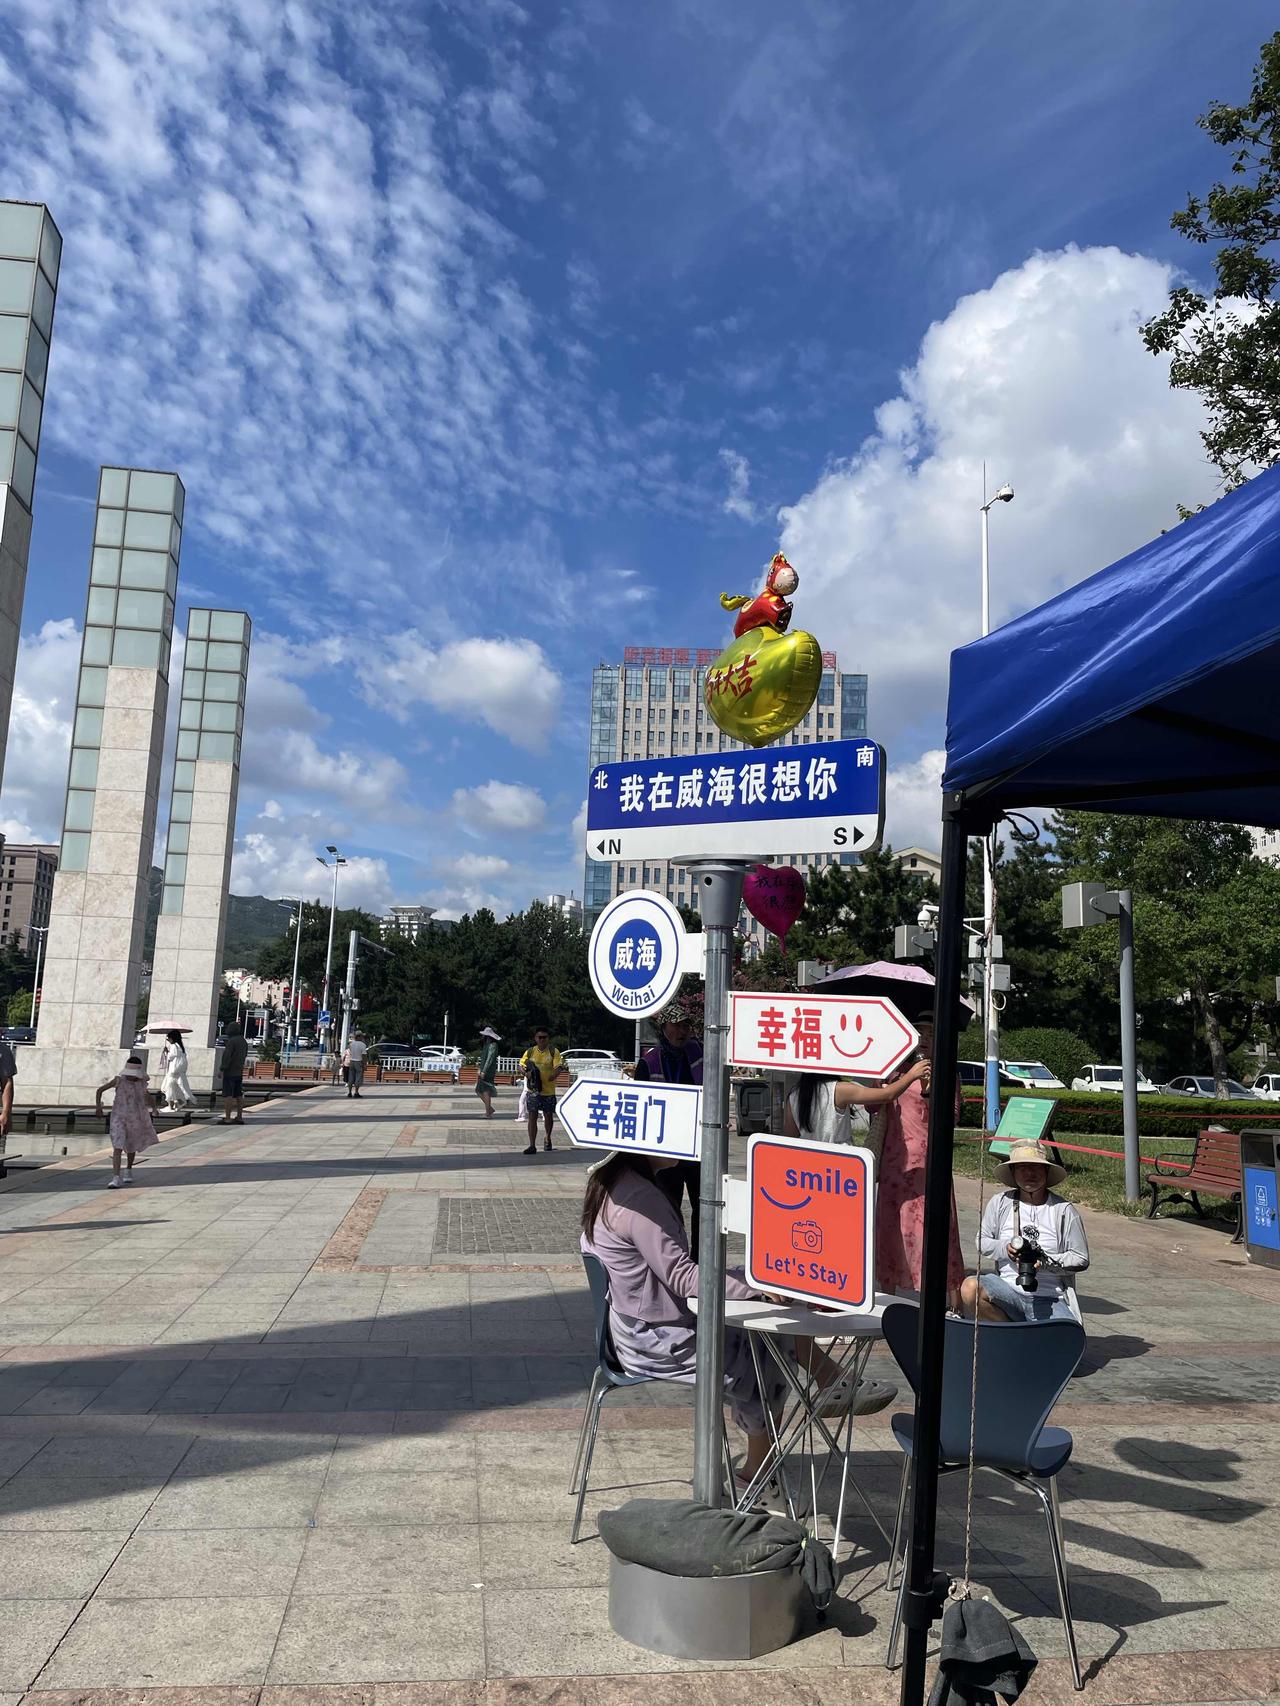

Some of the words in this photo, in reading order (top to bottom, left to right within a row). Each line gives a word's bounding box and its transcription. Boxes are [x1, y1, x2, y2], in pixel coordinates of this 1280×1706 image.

[856, 745, 875, 767] 南
[594, 771, 608, 789] 北
[619, 757, 838, 813] 我在威海很想你
[608, 839, 622, 855] N
[833, 827, 848, 845] S
[613, 937, 656, 972] 威海
[611, 984, 656, 1007] Weihai
[757, 1006, 823, 1060] 幸福
[586, 1090, 666, 1144] 幸福门
[785, 1167, 858, 1197] smile
[766, 1252, 805, 1277] Let's
[809, 1262, 848, 1290] Stay
